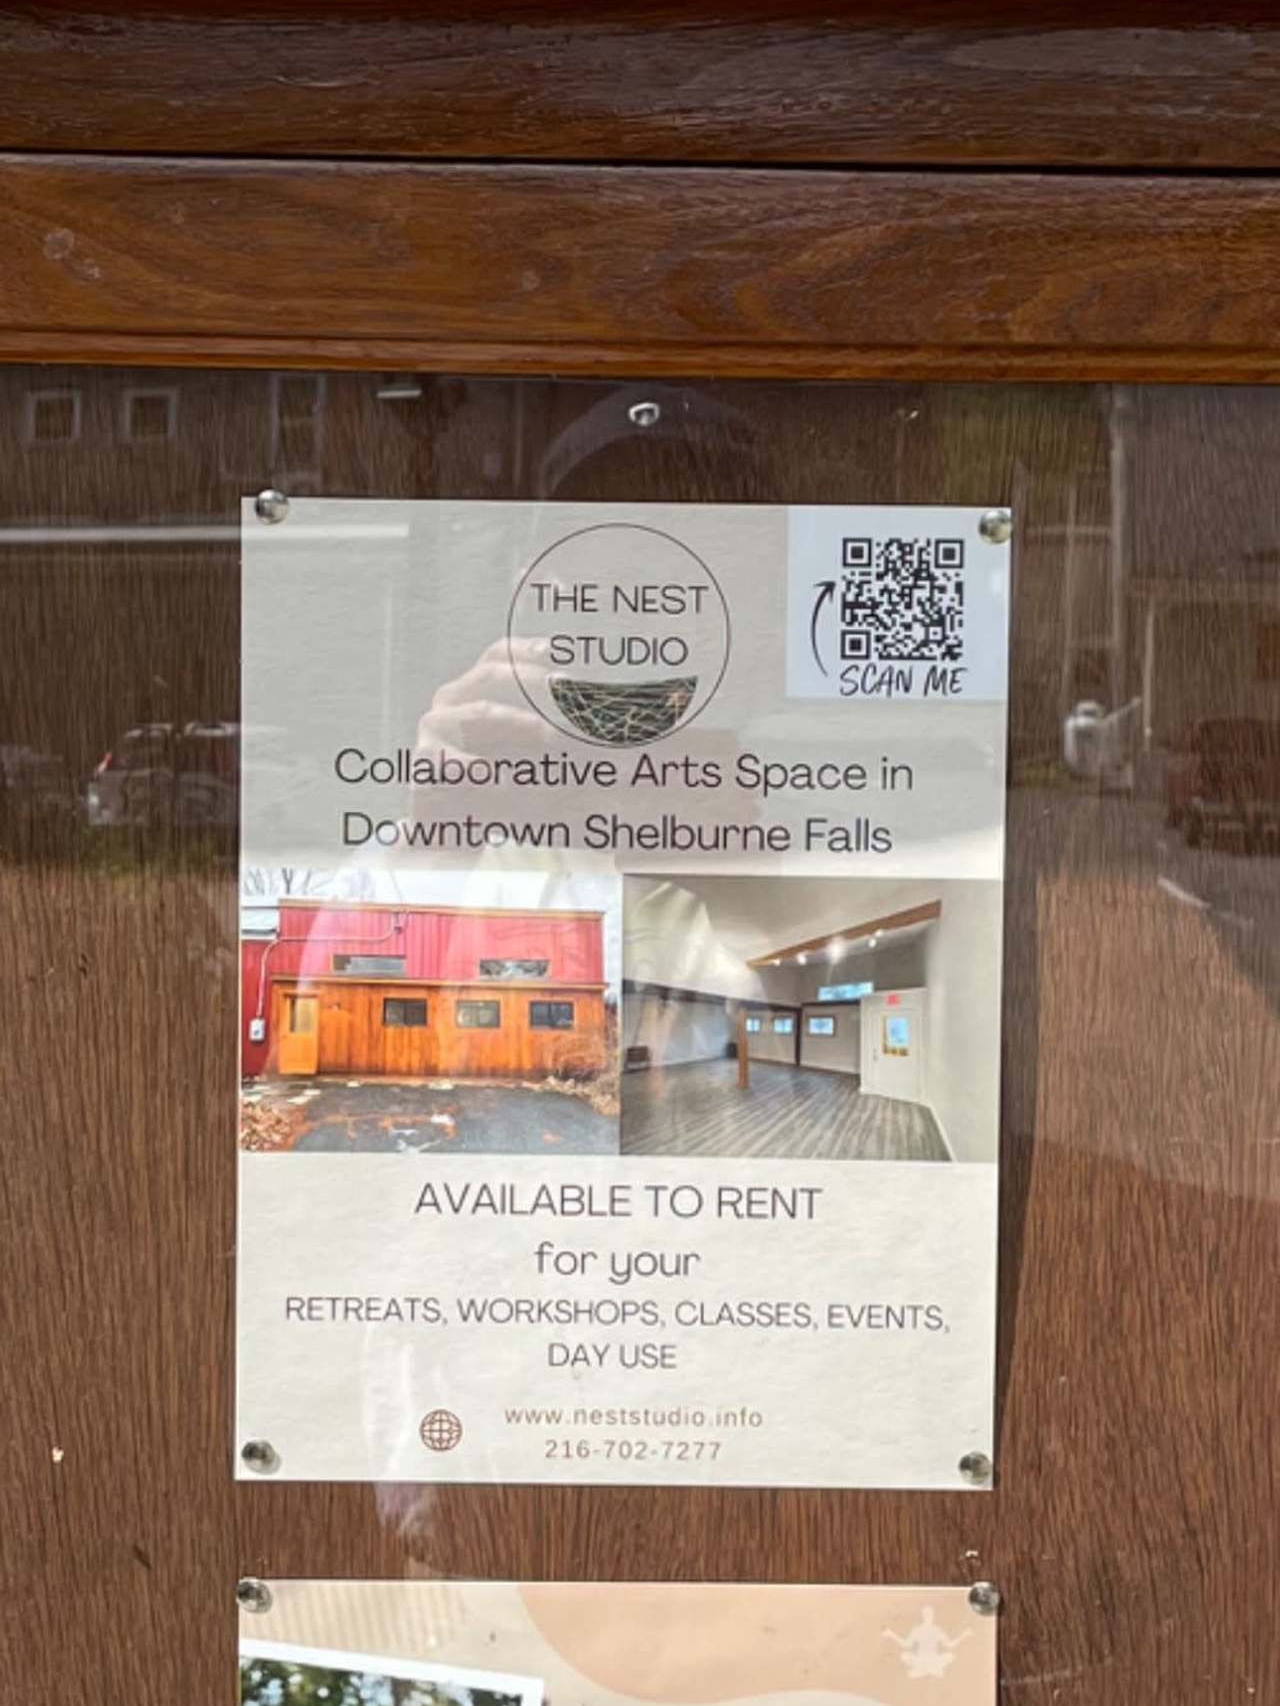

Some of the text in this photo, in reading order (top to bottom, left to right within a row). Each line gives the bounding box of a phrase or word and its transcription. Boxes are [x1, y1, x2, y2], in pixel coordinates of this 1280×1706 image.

[530, 583, 709, 615] THE NEST
[550, 637, 688, 666] STUDIO
[839, 665, 968, 696] SCAN ME
[333, 748, 914, 797] Collaborative Arts Space in
[342, 812, 893, 854] Downtown Shelburne Falls
[414, 1183, 823, 1220] AVAILABLE TO RENT
[534, 1241, 700, 1283] for your
[285, 1296, 951, 1332] RETREATS, WORKSHOPS, CLASSES, EVENTS,
[547, 1343, 677, 1369] DAY USE
[504, 1405, 763, 1428] www.neststudio.info
[545, 1439, 722, 1462] 216-702-7277
